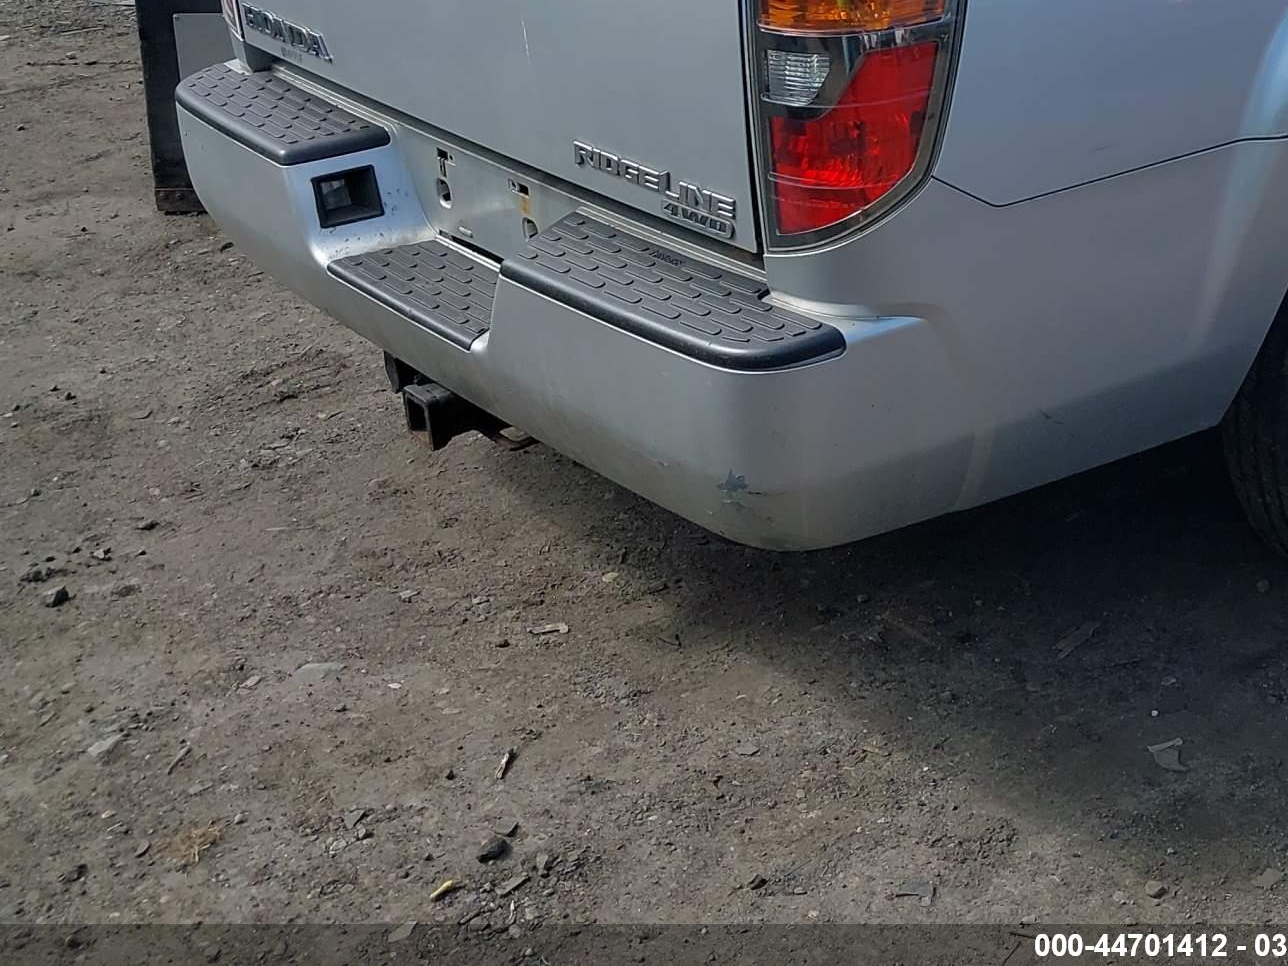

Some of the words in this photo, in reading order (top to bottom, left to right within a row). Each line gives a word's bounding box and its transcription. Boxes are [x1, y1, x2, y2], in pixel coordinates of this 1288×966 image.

[241, 2, 334, 63] HONDA
[572, 139, 737, 220] RIDGELINE
[662, 200, 732, 237] 4WD
